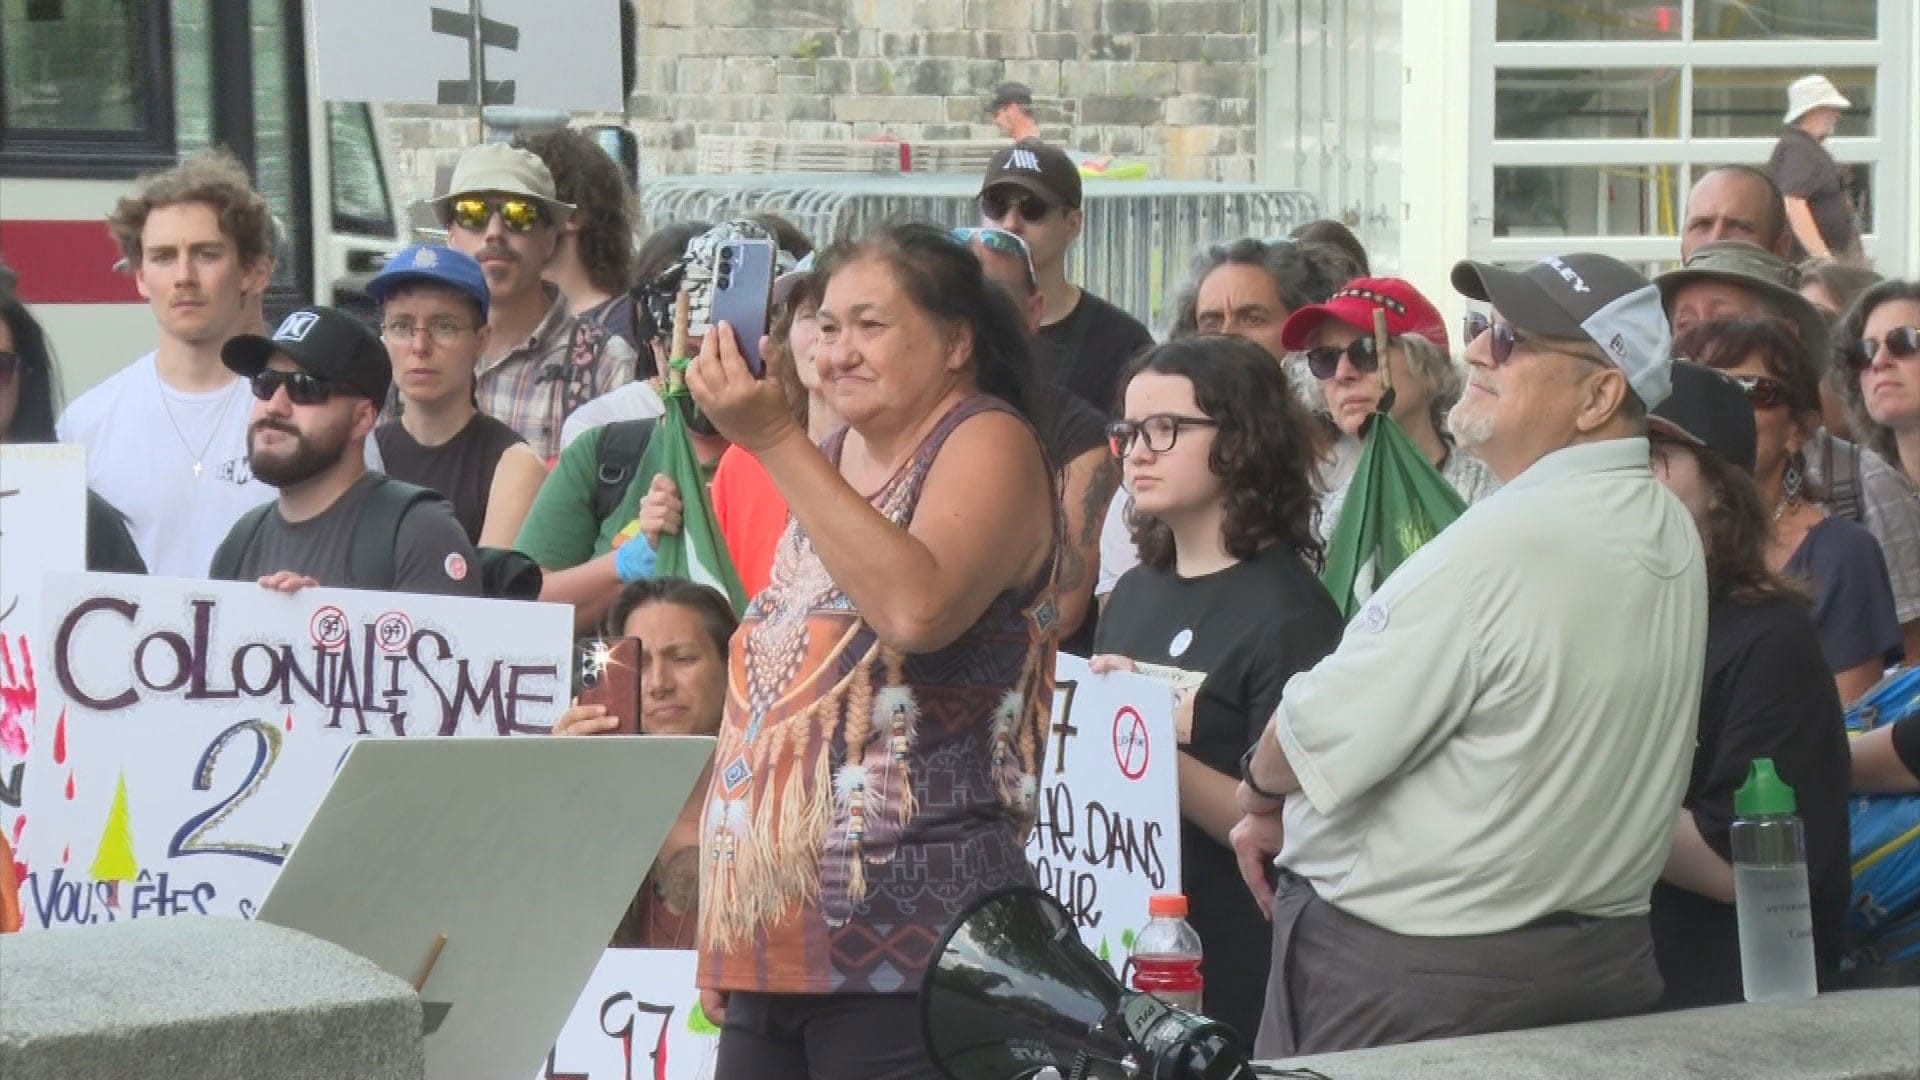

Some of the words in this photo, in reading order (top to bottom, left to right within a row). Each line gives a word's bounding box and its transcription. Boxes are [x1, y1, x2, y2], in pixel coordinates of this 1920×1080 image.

[1083, 800, 1166, 889] DANS
[29, 868, 117, 929] VOUS
[600, 990, 676, 1080] 97
